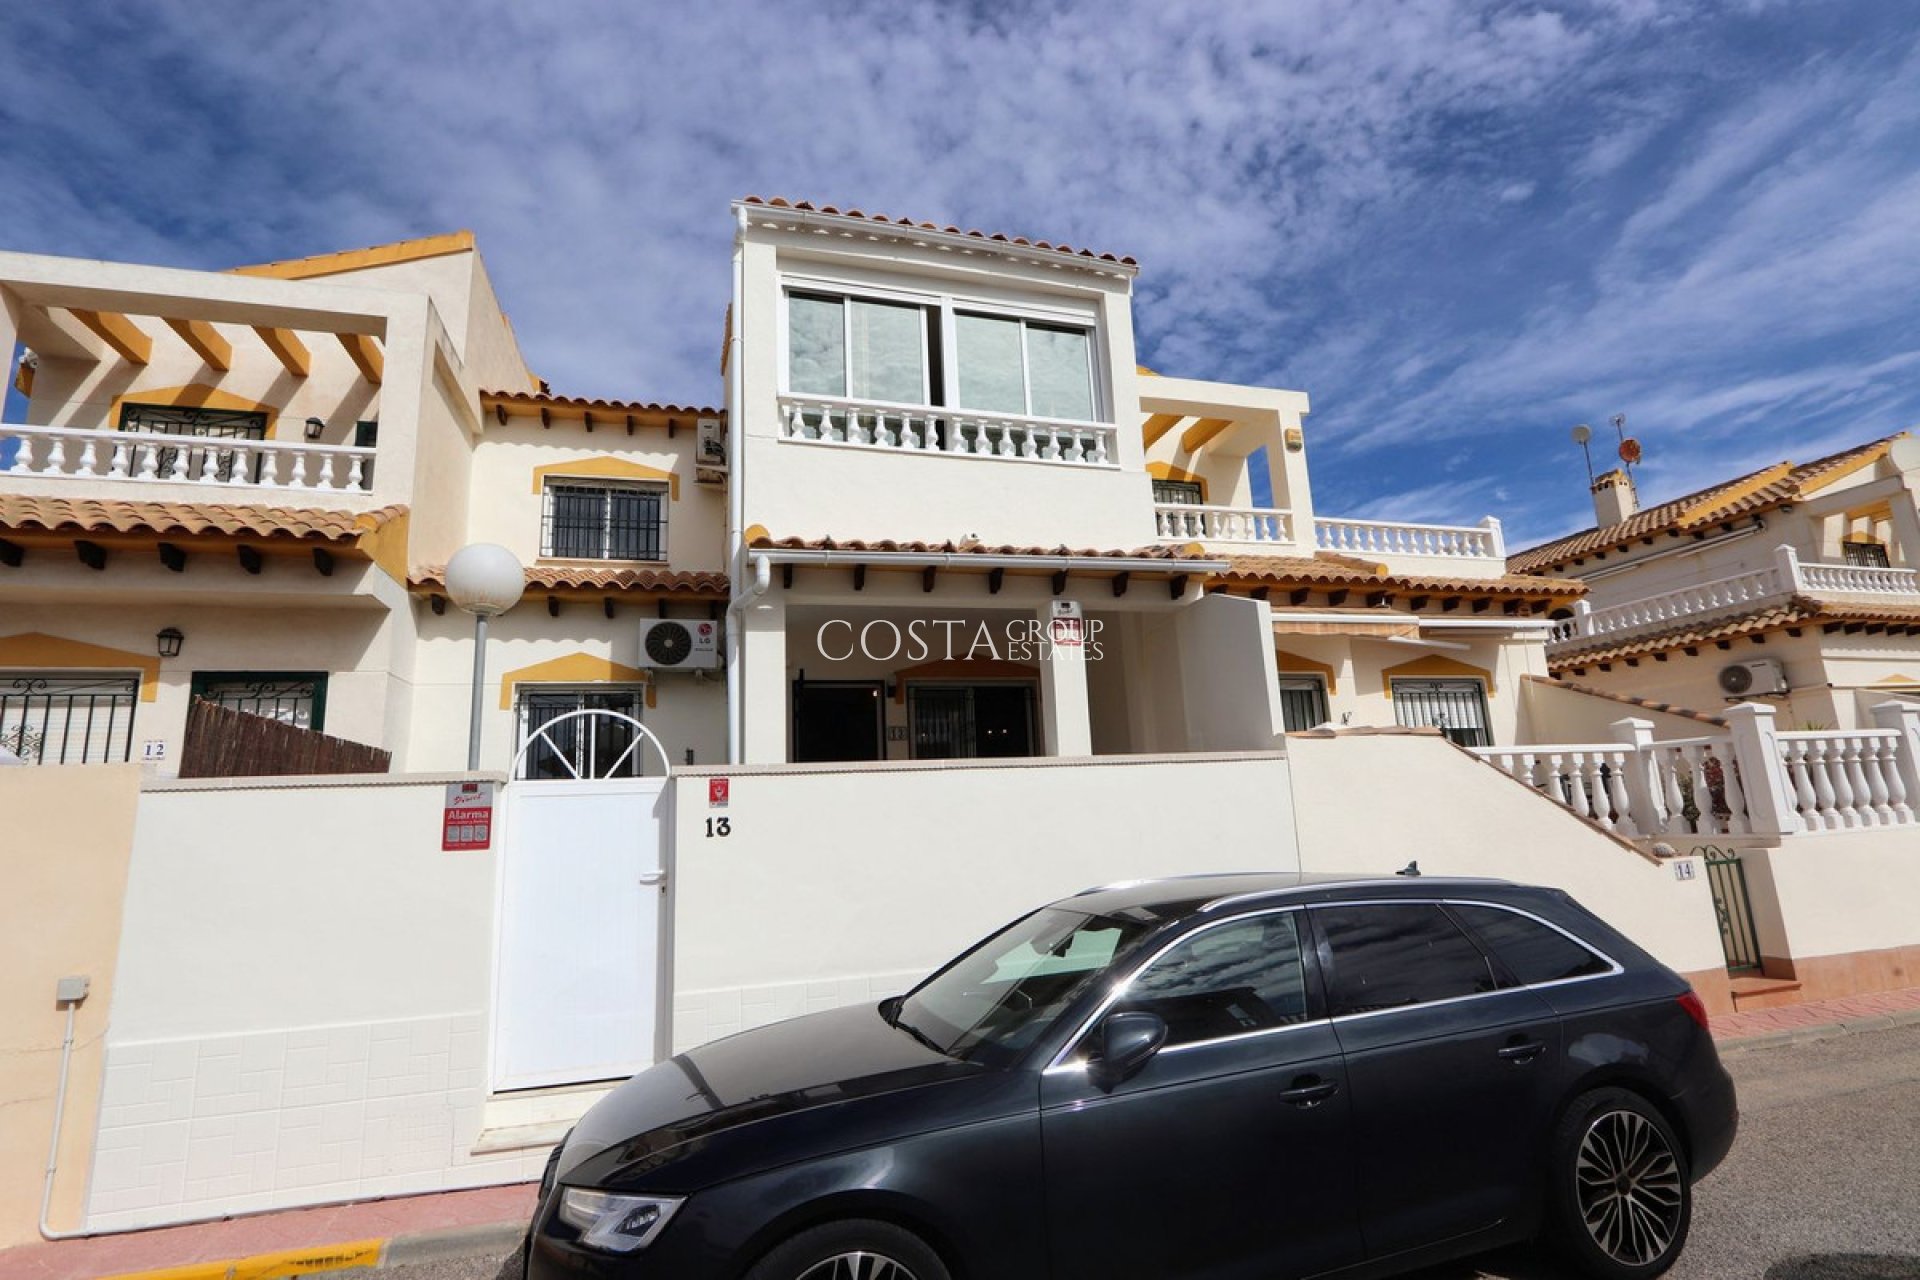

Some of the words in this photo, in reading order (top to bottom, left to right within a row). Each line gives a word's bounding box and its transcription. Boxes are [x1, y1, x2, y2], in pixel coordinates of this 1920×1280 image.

[145, 743, 164, 756] 12
[447, 810, 489, 820] Alarma
[706, 816, 731, 838] 13
[1677, 863, 1692, 880] 14
